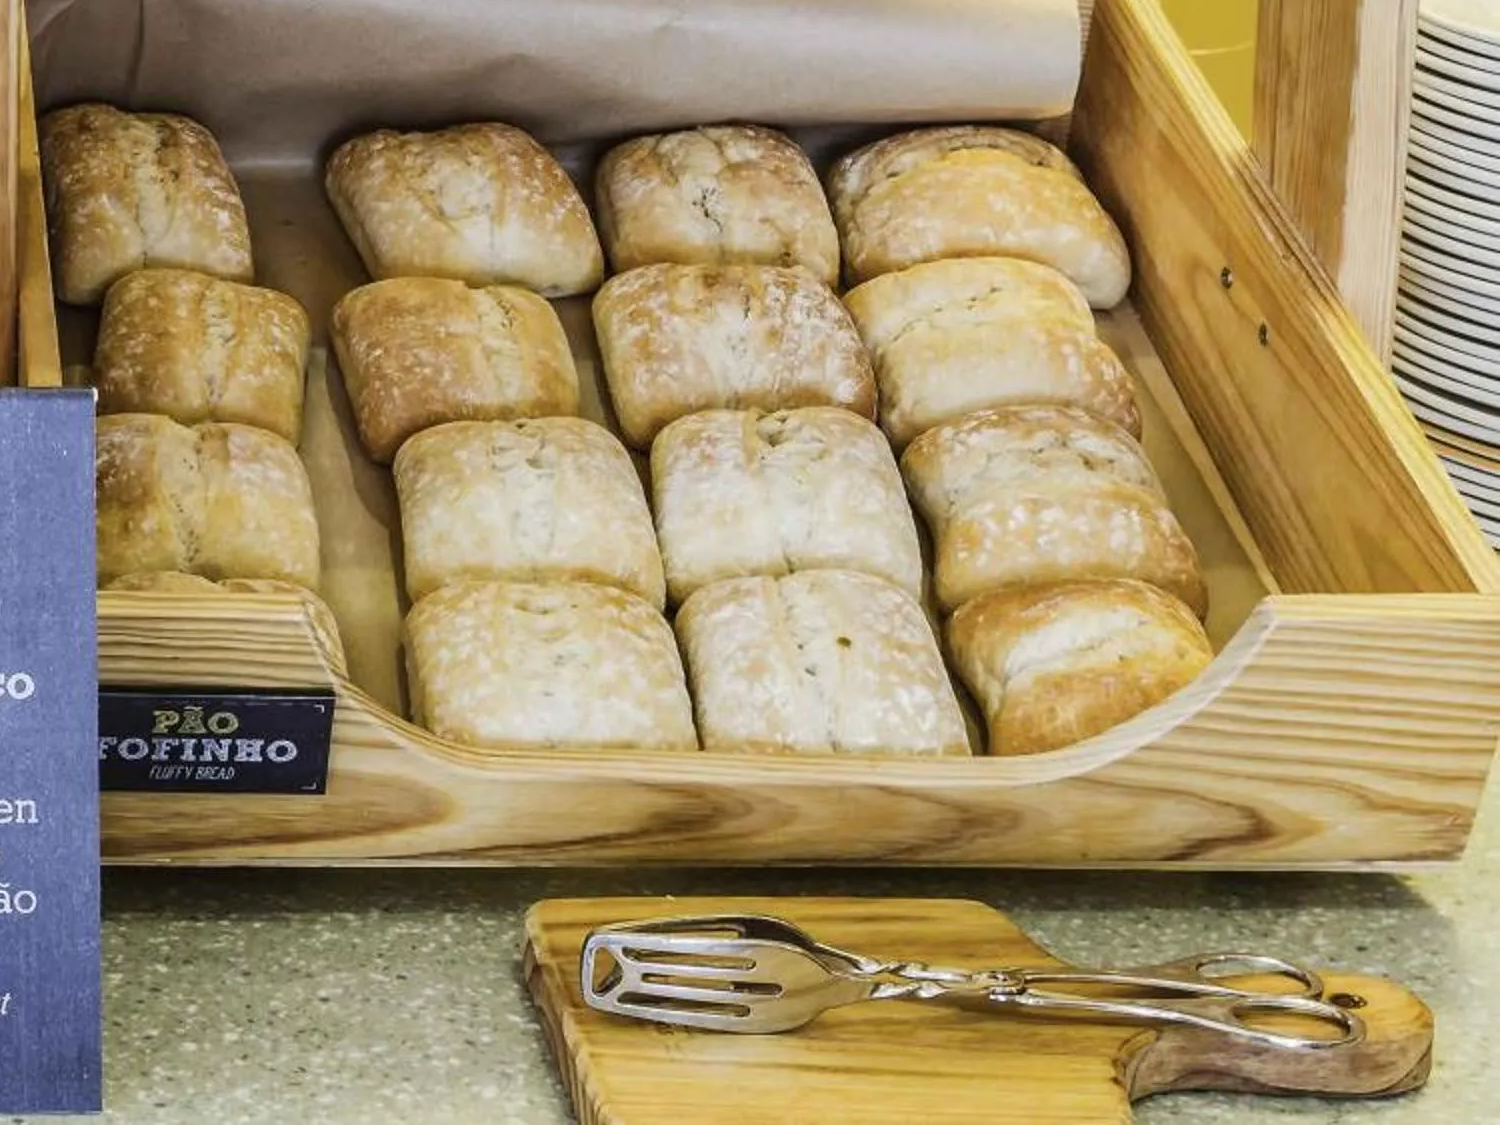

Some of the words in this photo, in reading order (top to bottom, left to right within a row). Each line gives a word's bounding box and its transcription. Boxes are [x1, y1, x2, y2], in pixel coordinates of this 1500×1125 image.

[152, 706, 240, 734] PÃO
[99, 738, 298, 762] FOFINHO
[149, 765, 193, 780] FLUFFY
[195, 766, 235, 780] BREAD
